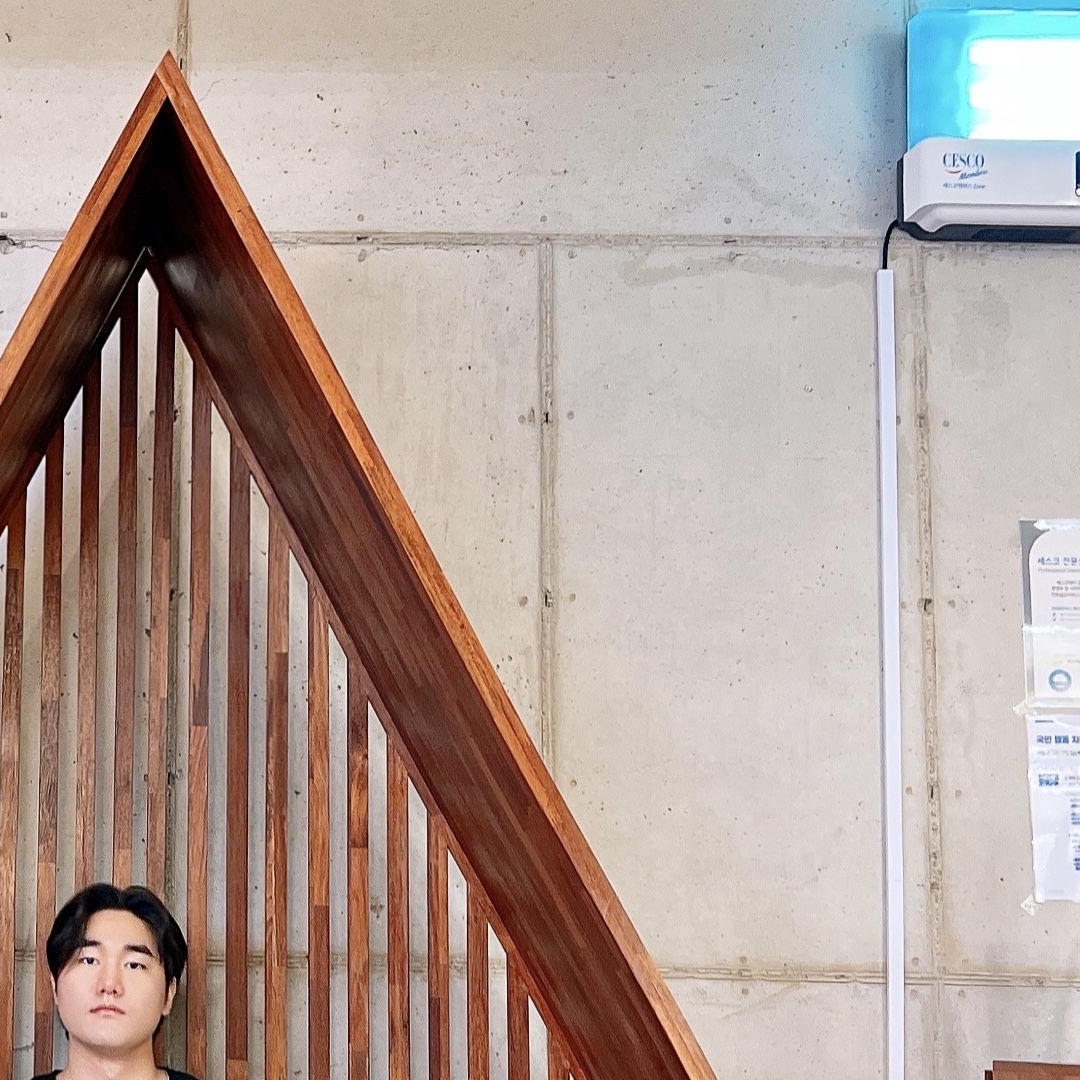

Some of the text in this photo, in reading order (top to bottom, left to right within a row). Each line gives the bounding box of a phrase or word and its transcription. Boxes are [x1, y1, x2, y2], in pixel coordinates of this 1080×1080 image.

[943, 153, 985, 168] CESCO
[1038, 556, 1080, 566] 세스코 전문
